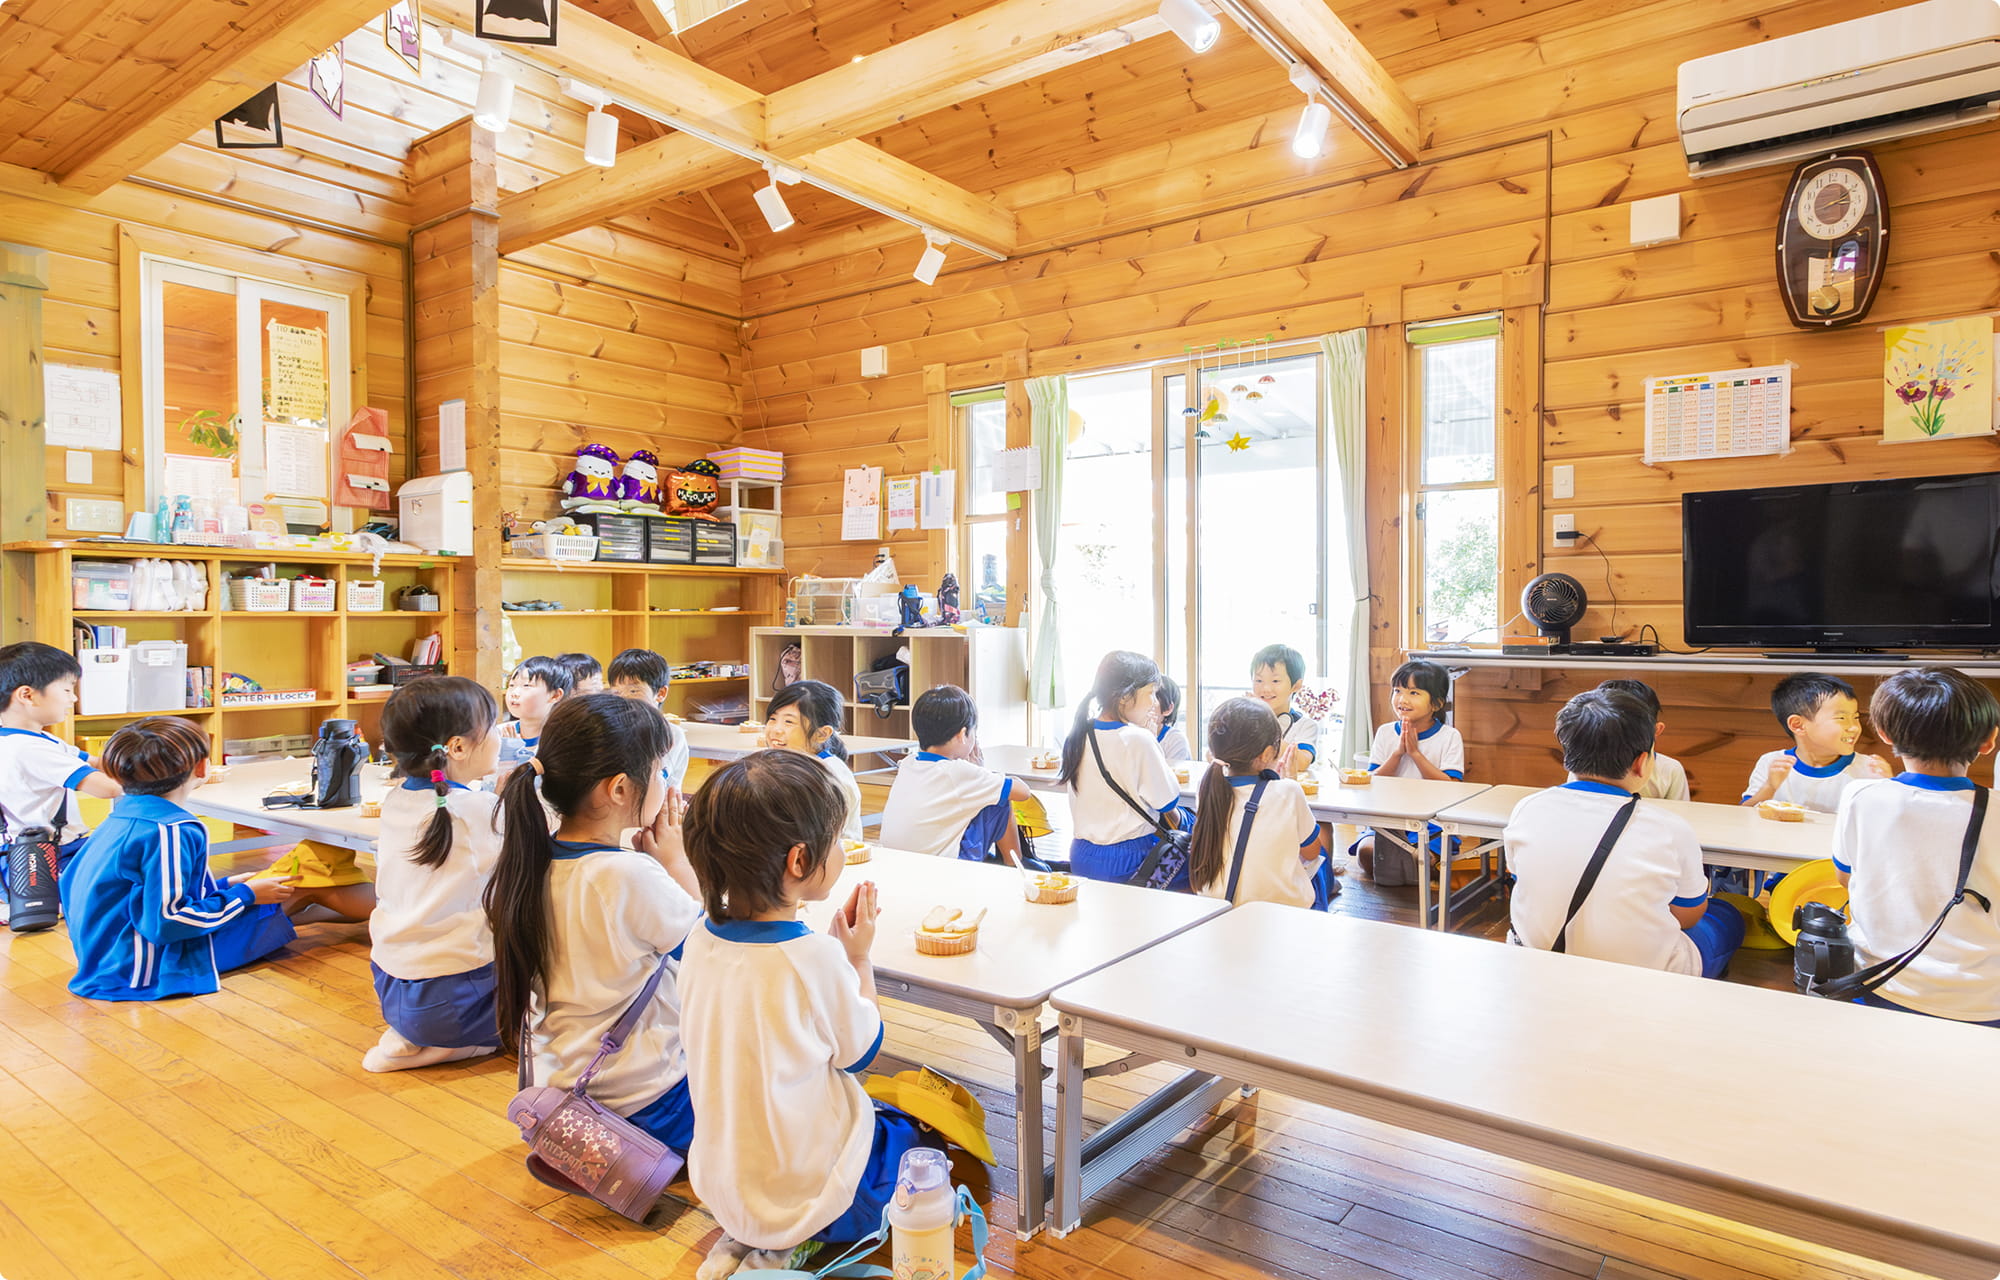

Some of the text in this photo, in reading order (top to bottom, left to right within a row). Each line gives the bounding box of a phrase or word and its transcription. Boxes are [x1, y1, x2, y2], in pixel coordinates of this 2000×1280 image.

[1828, 172, 1839, 183] 12
[678, 490, 716, 503] HALLOWEEN
[222, 691, 310, 704] PATTERN BLOCKS
